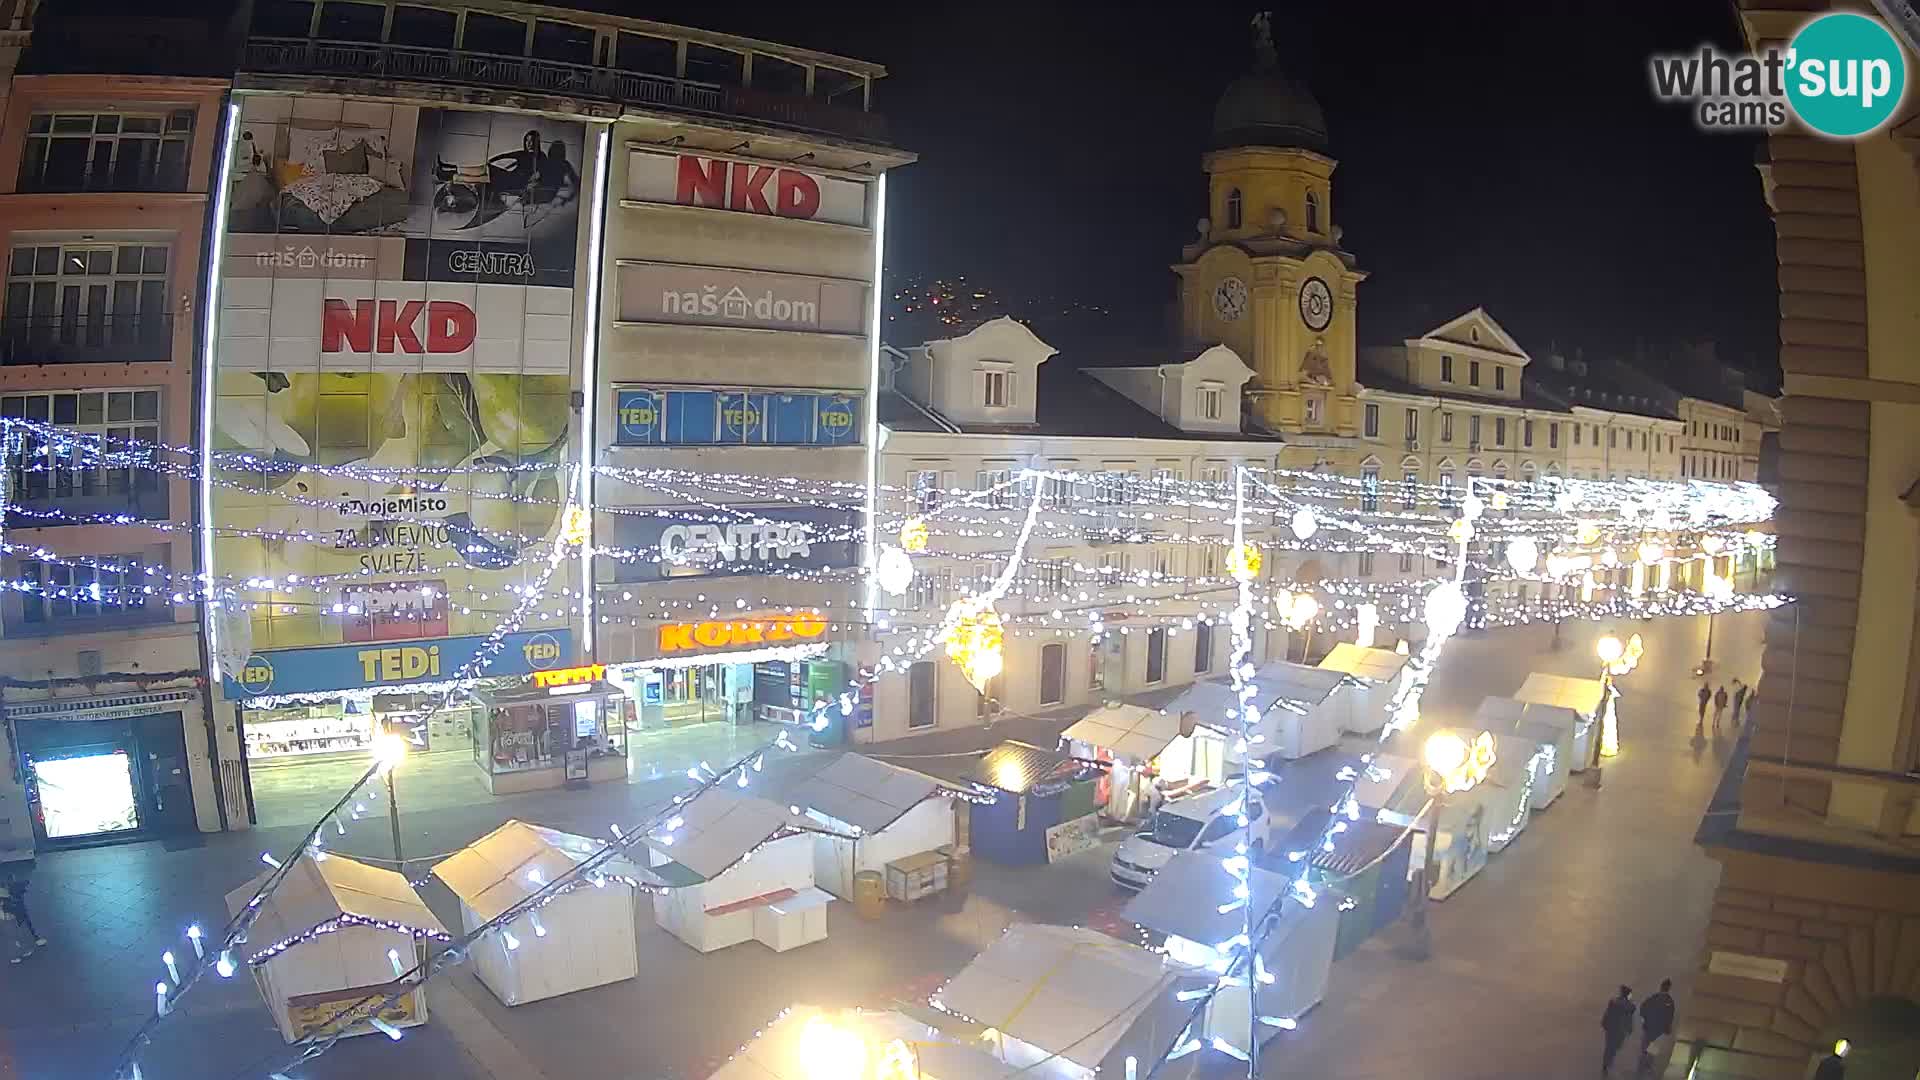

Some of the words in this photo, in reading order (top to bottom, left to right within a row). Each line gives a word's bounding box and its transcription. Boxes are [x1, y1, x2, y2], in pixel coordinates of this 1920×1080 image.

[676, 154, 821, 220] NKD
[256, 247, 295, 268] naš
[320, 248, 367, 269] dom
[448, 250, 535, 276] CENTRA
[662, 285, 718, 316] naš
[754, 291, 816, 323] dom
[321, 298, 478, 354] NKD
[723, 409, 760, 425] TEDi
[339, 497, 447, 516] #TvojeMisto
[334, 528, 357, 549] ZA
[660, 522, 810, 561] CENTRA
[358, 646, 441, 682] TEDi
[523, 643, 560, 660] TEDi
[533, 664, 605, 688] TOMMY
